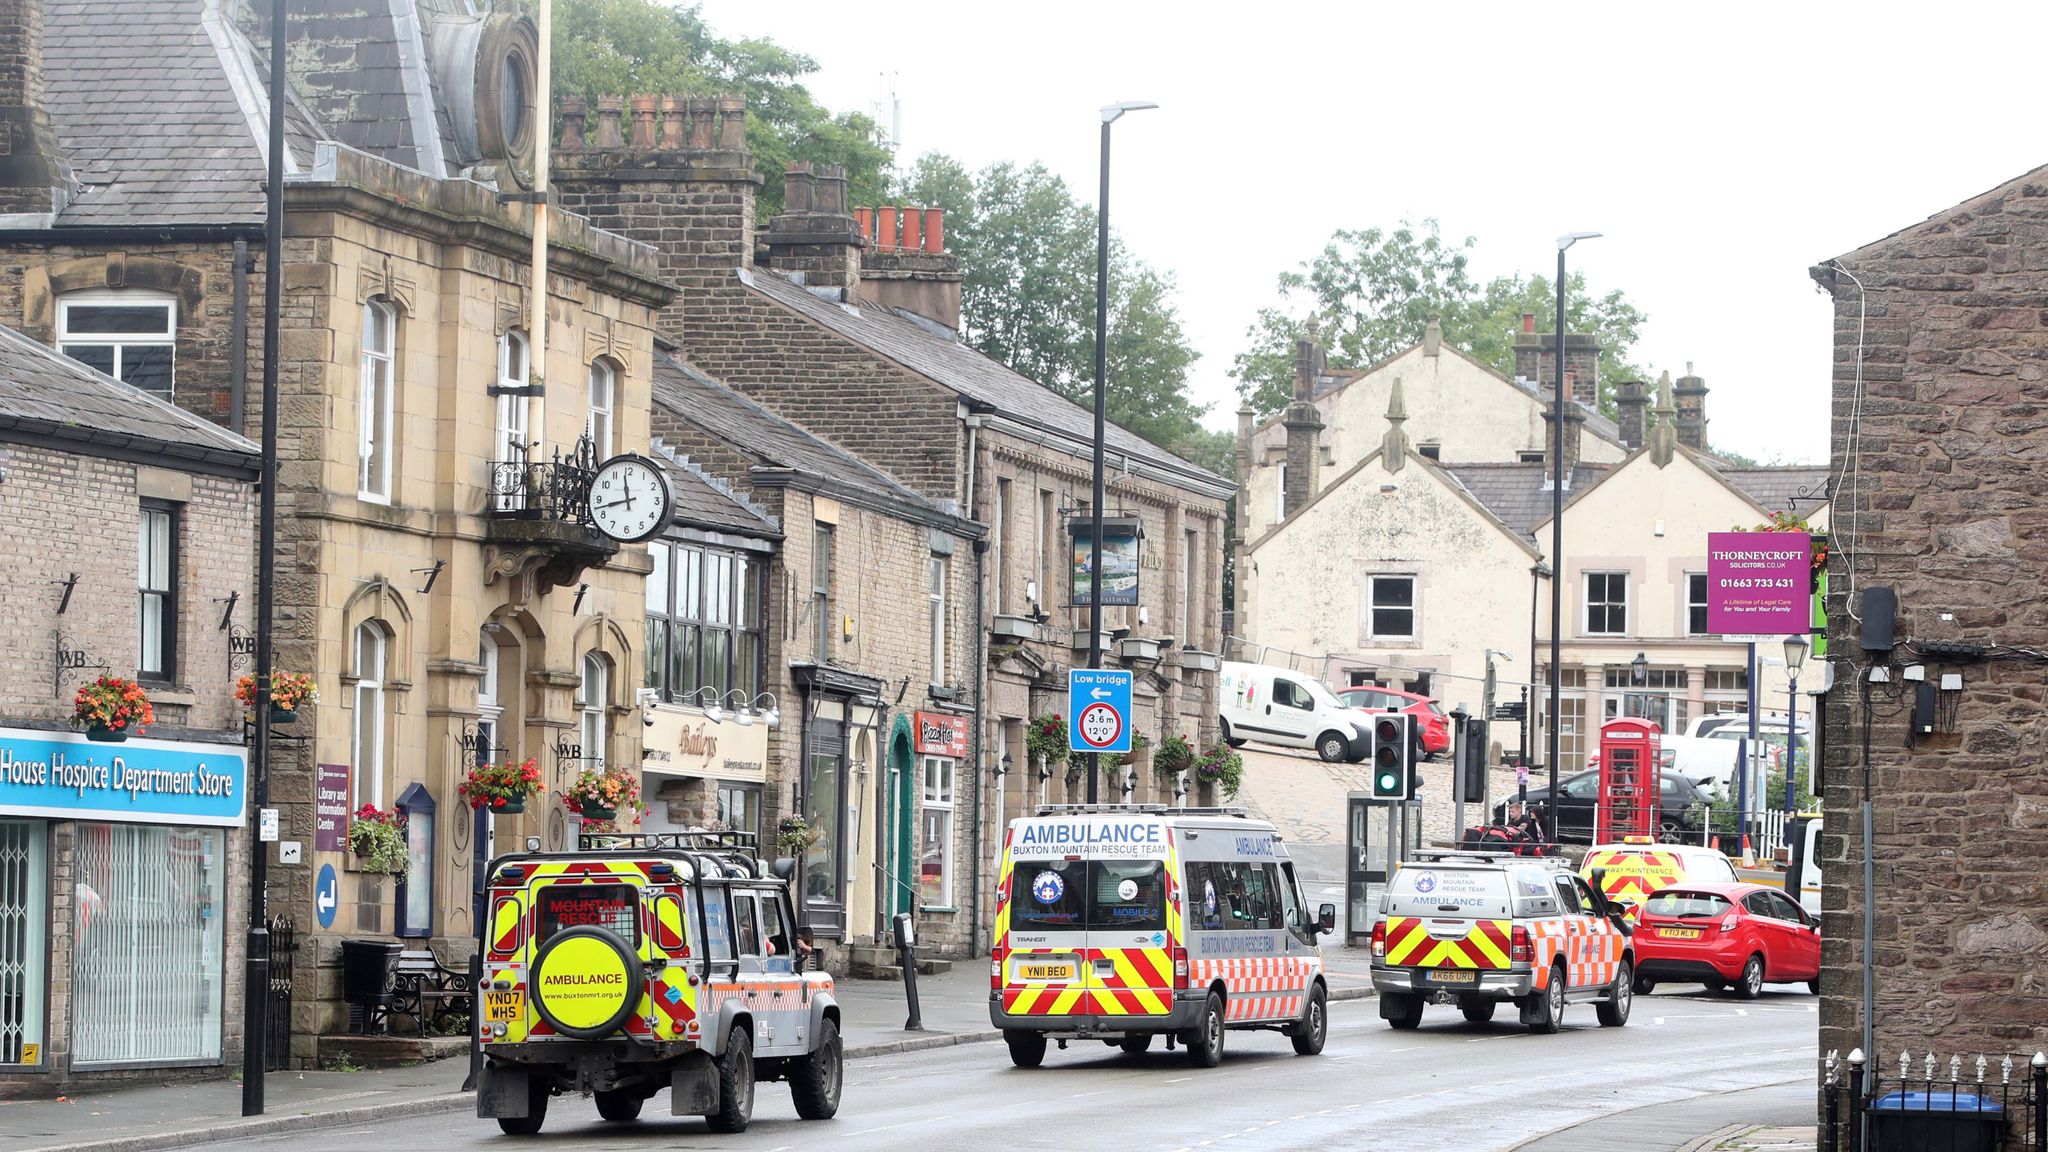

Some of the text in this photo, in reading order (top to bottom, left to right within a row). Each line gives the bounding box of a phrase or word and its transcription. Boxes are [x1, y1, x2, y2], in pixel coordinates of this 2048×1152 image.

[612, 471, 618, 480] 11
[601, 480, 611, 490] 10
[650, 482, 656, 491] 2
[596, 495, 602, 504] 9
[654, 496, 660, 506] 3
[600, 511, 606, 519] 8
[648, 512, 655, 520] 4
[610, 521, 616, 529] 7
[624, 525, 629, 534] 6
[639, 521, 645, 530] 5
[1712, 551, 1803, 560] THORNEYCROFT
[1720, 579, 1793, 588] 01663 733 431
[231, 637, 257, 653] WB
[59, 650, 86, 668] WB
[1074, 674, 1127, 686] Low bridge
[1088, 714, 1104, 723] 3.6
[559, 744, 581, 759] WB
[0, 749, 233, 801] House Hospice Department Store
[318, 786, 347, 803] Library and
[317, 802, 347, 816] Information
[317, 817, 335, 831] Centre
[1022, 824, 1160, 844] AMBULANCE
[1013, 844, 1166, 855] BUXTON MOUNTAIN RESCUE TEAM
[550, 899, 625, 912] MOUNTAIN
[1412, 896, 1484, 906] AMBULANCE
[1113, 908, 1158, 917] MOBILE 2
[558, 912, 617, 924] RESCUE
[1027, 967, 1066, 976] YN11 BEO
[1431, 971, 1474, 981] AK66 URU
[544, 974, 623, 986] AMBULANCE
[487, 993, 520, 1005] YN07
[544, 992, 623, 1000] www.buxtonmrt.org.uk
[492, 1006, 516, 1019] WHS
